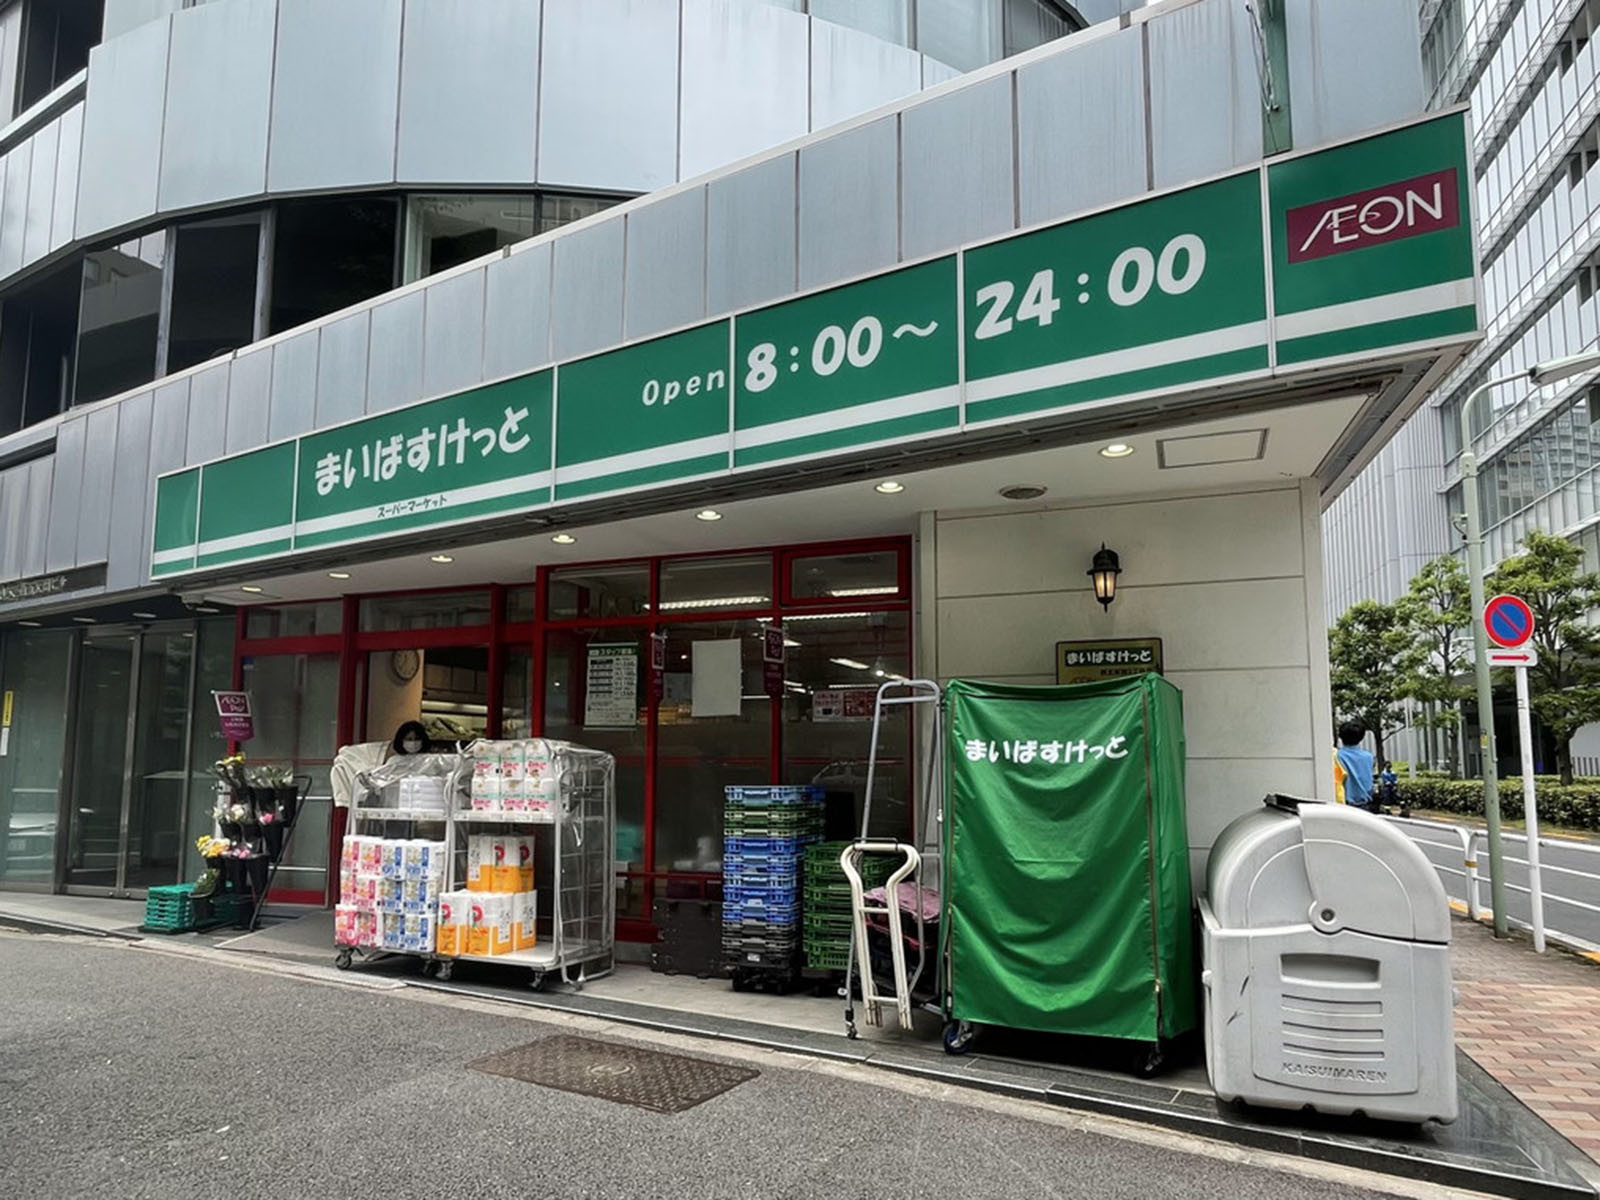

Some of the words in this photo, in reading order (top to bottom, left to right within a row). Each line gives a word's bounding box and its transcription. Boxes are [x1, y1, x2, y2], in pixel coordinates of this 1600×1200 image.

[642, 369, 726, 406] Open
[314, 406, 532, 497] まいばすけっと
[377, 494, 448, 519] スーパーマーケット
[1067, 650, 1152, 665] まいばすけっと
[965, 735, 1129, 764] まいばすけっと
[1281, 1061, 1388, 1084] KAISUIMAREN
